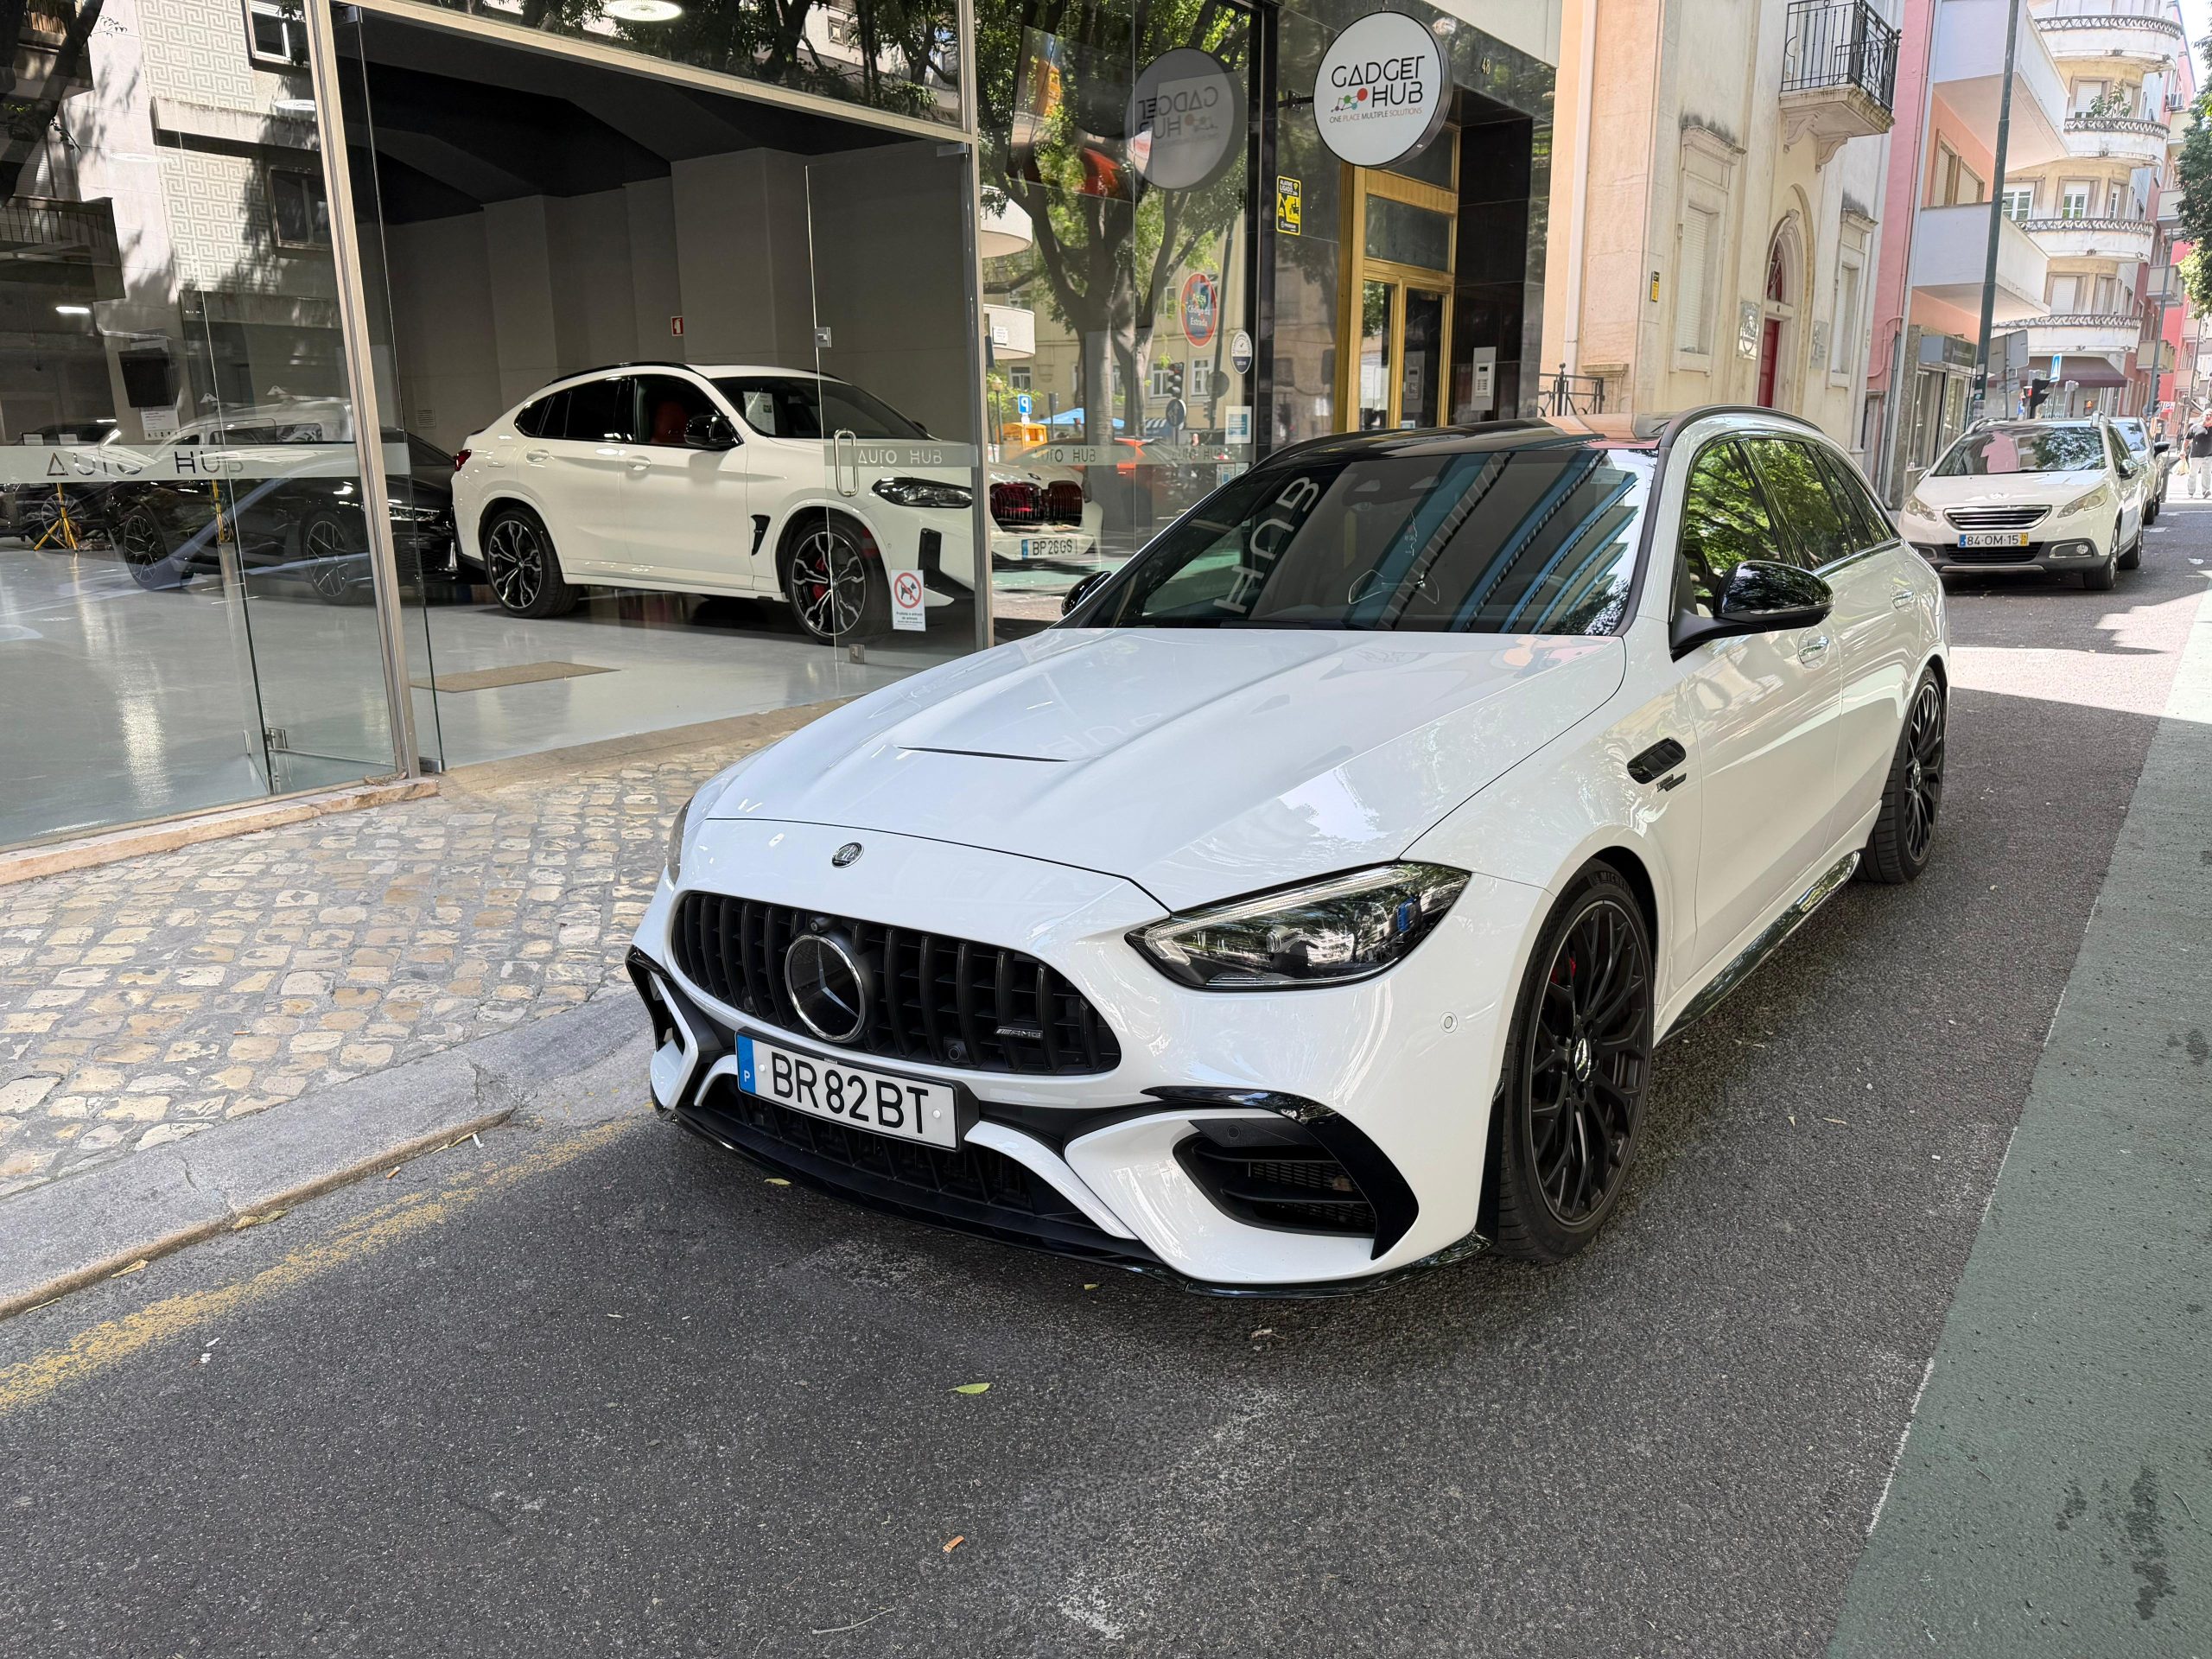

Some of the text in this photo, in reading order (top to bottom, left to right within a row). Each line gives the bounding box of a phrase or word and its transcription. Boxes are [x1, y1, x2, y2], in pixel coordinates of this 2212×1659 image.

[1331, 55, 1425, 87] GADGET
[1481, 57, 1491, 75] 48
[1372, 81, 1423, 108] HUB
[1329, 107, 1423, 124] ONE PLACE MULTIPLE SOLUTIONS
[858, 449, 943, 464] AUTO HUB
[1010, 1029, 1041, 1039] AMG
[743, 1070, 751, 1083] P
